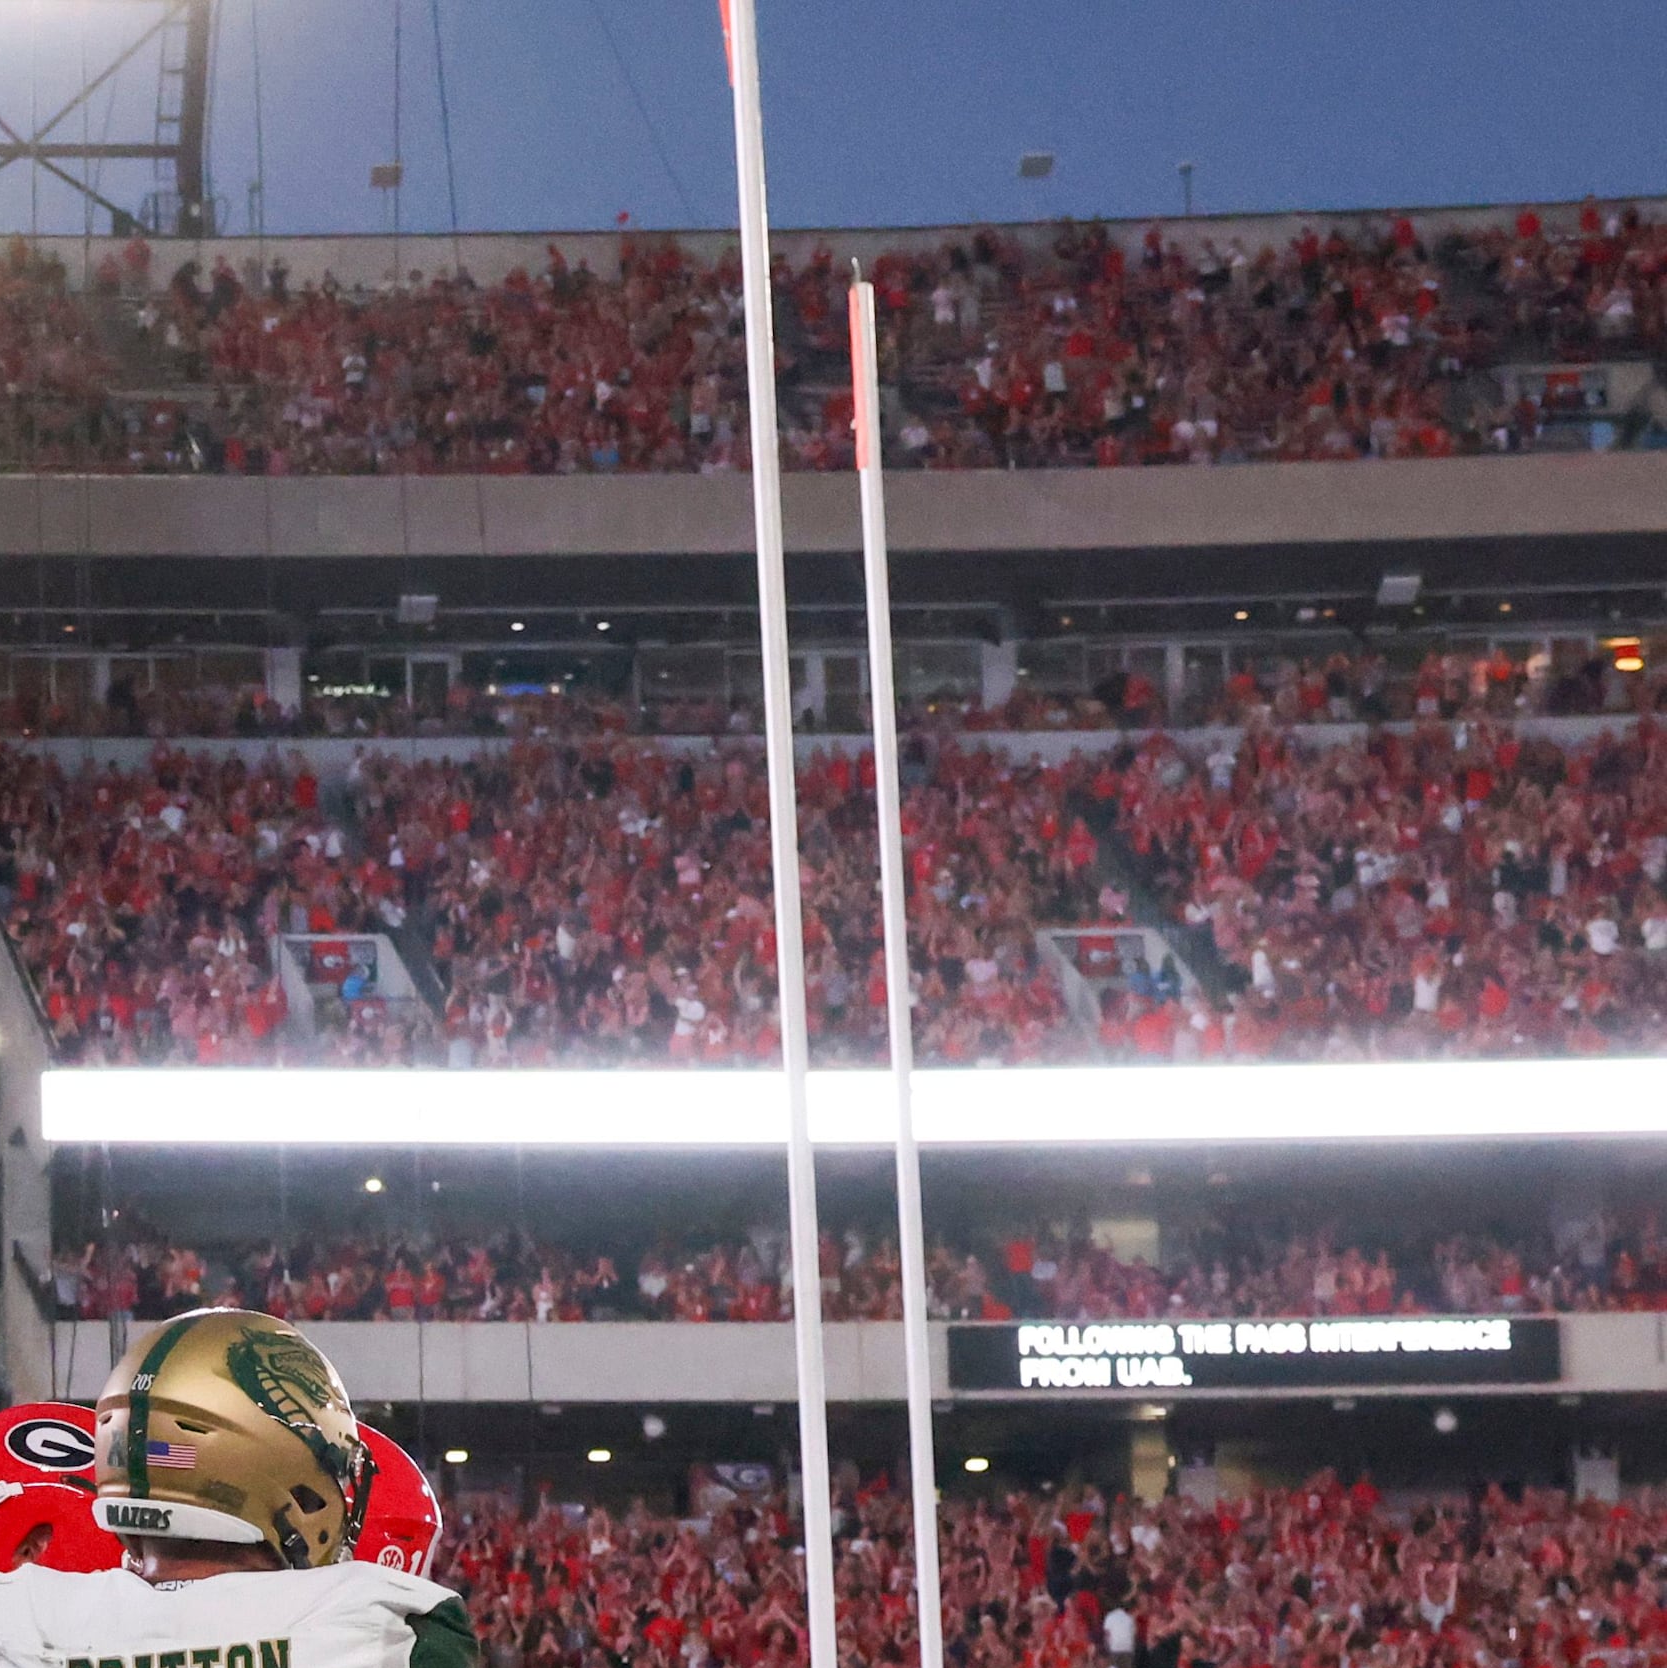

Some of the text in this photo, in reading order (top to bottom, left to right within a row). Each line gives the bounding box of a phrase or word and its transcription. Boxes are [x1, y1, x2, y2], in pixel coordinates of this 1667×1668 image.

[1018, 1320, 1511, 1355] FOLLOWING THE PASS INTERFERENCE
[131, 1374, 155, 1391] 205
[1020, 1356, 1193, 1387] FROM UAB.
[106, 1504, 173, 1529] BLAZERS
